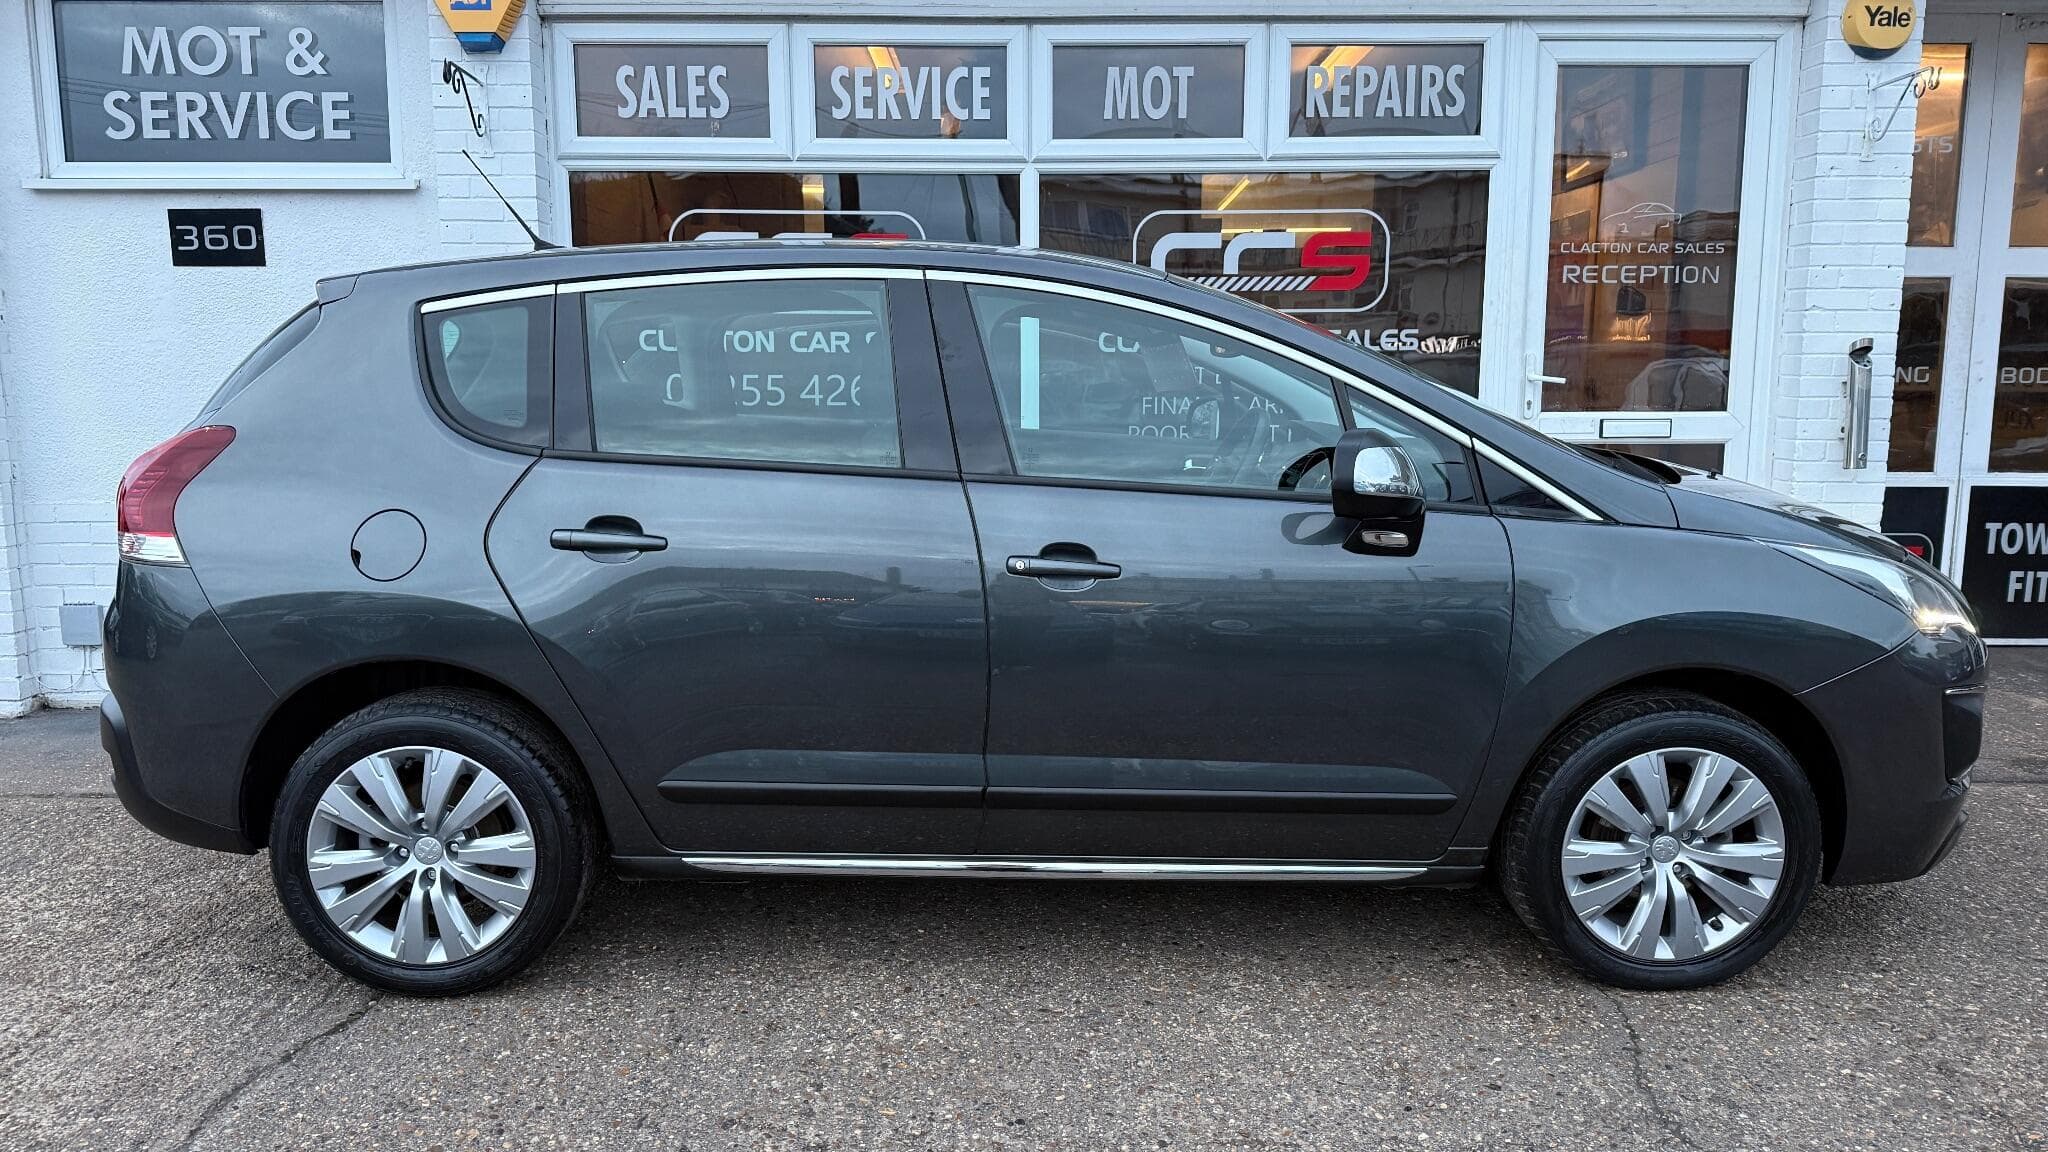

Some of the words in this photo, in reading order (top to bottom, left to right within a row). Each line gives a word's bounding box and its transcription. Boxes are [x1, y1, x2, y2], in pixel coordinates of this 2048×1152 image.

[1864, 5, 1911, 28] Yale
[121, 26, 262, 75] MOT
[285, 26, 328, 75] &
[615, 65, 731, 119] SALES
[830, 65, 991, 120] SERVICE
[1102, 66, 1195, 120] MOT
[1305, 64, 1466, 118] REPAIRS
[103, 91, 352, 140] SERVICE
[175, 225, 258, 251] 360
[1560, 242, 1632, 254] CLACTON
[1637, 242, 1669, 254] CAR
[1674, 242, 1726, 254] SALES
[1562, 265, 1720, 284] RECEPTION
[789, 331, 851, 353] CAR
[1328, 329, 1420, 350] ALES
[2000, 366, 2048, 384] BOD
[1985, 522, 2048, 555] TOW
[2007, 571, 2048, 602] FIT
